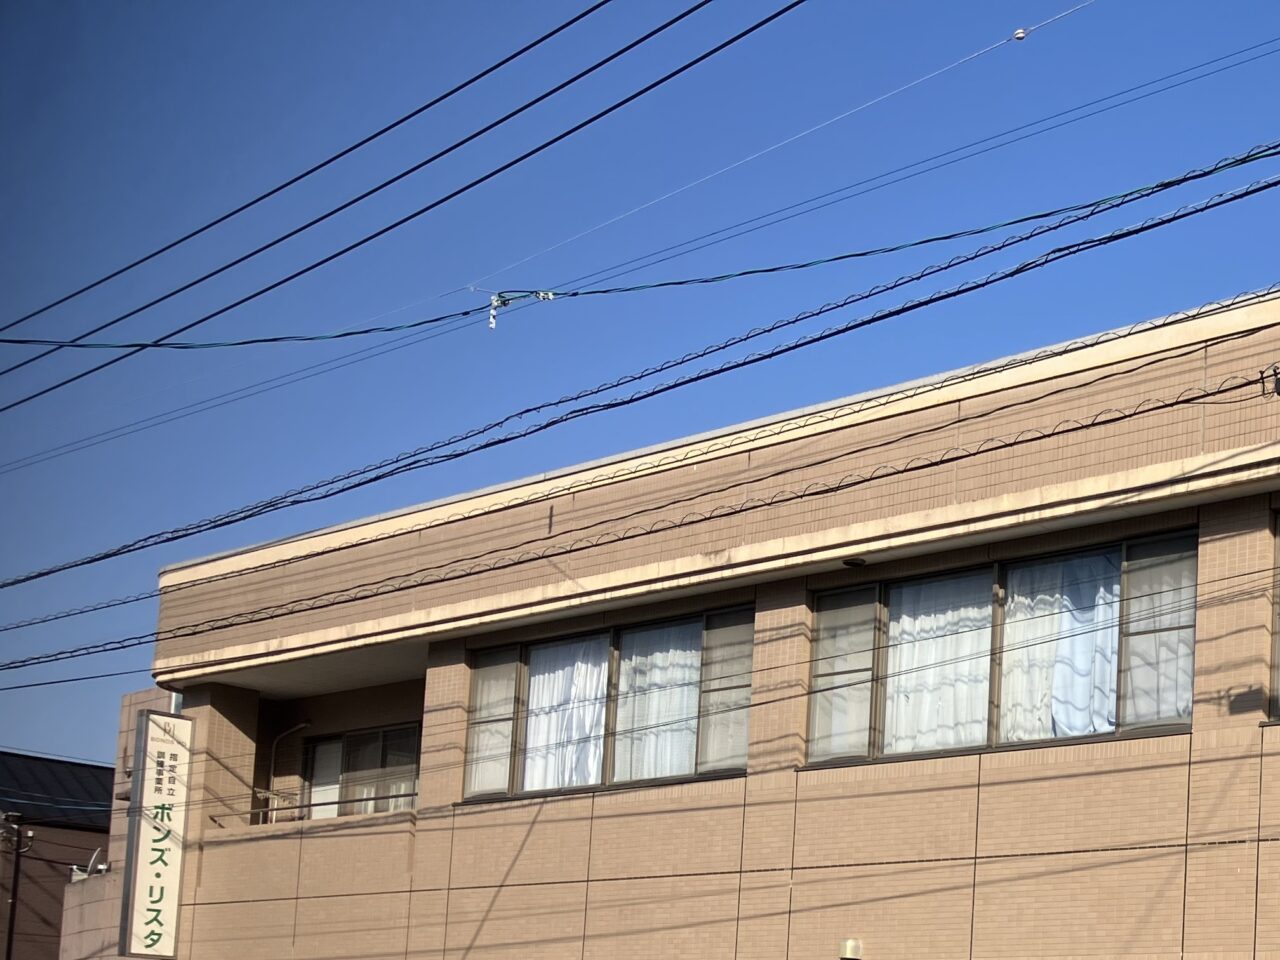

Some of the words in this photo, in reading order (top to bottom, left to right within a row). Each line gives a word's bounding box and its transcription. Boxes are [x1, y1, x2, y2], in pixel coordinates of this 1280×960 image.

[144, 803, 174, 949] ボンズ・リスタ
